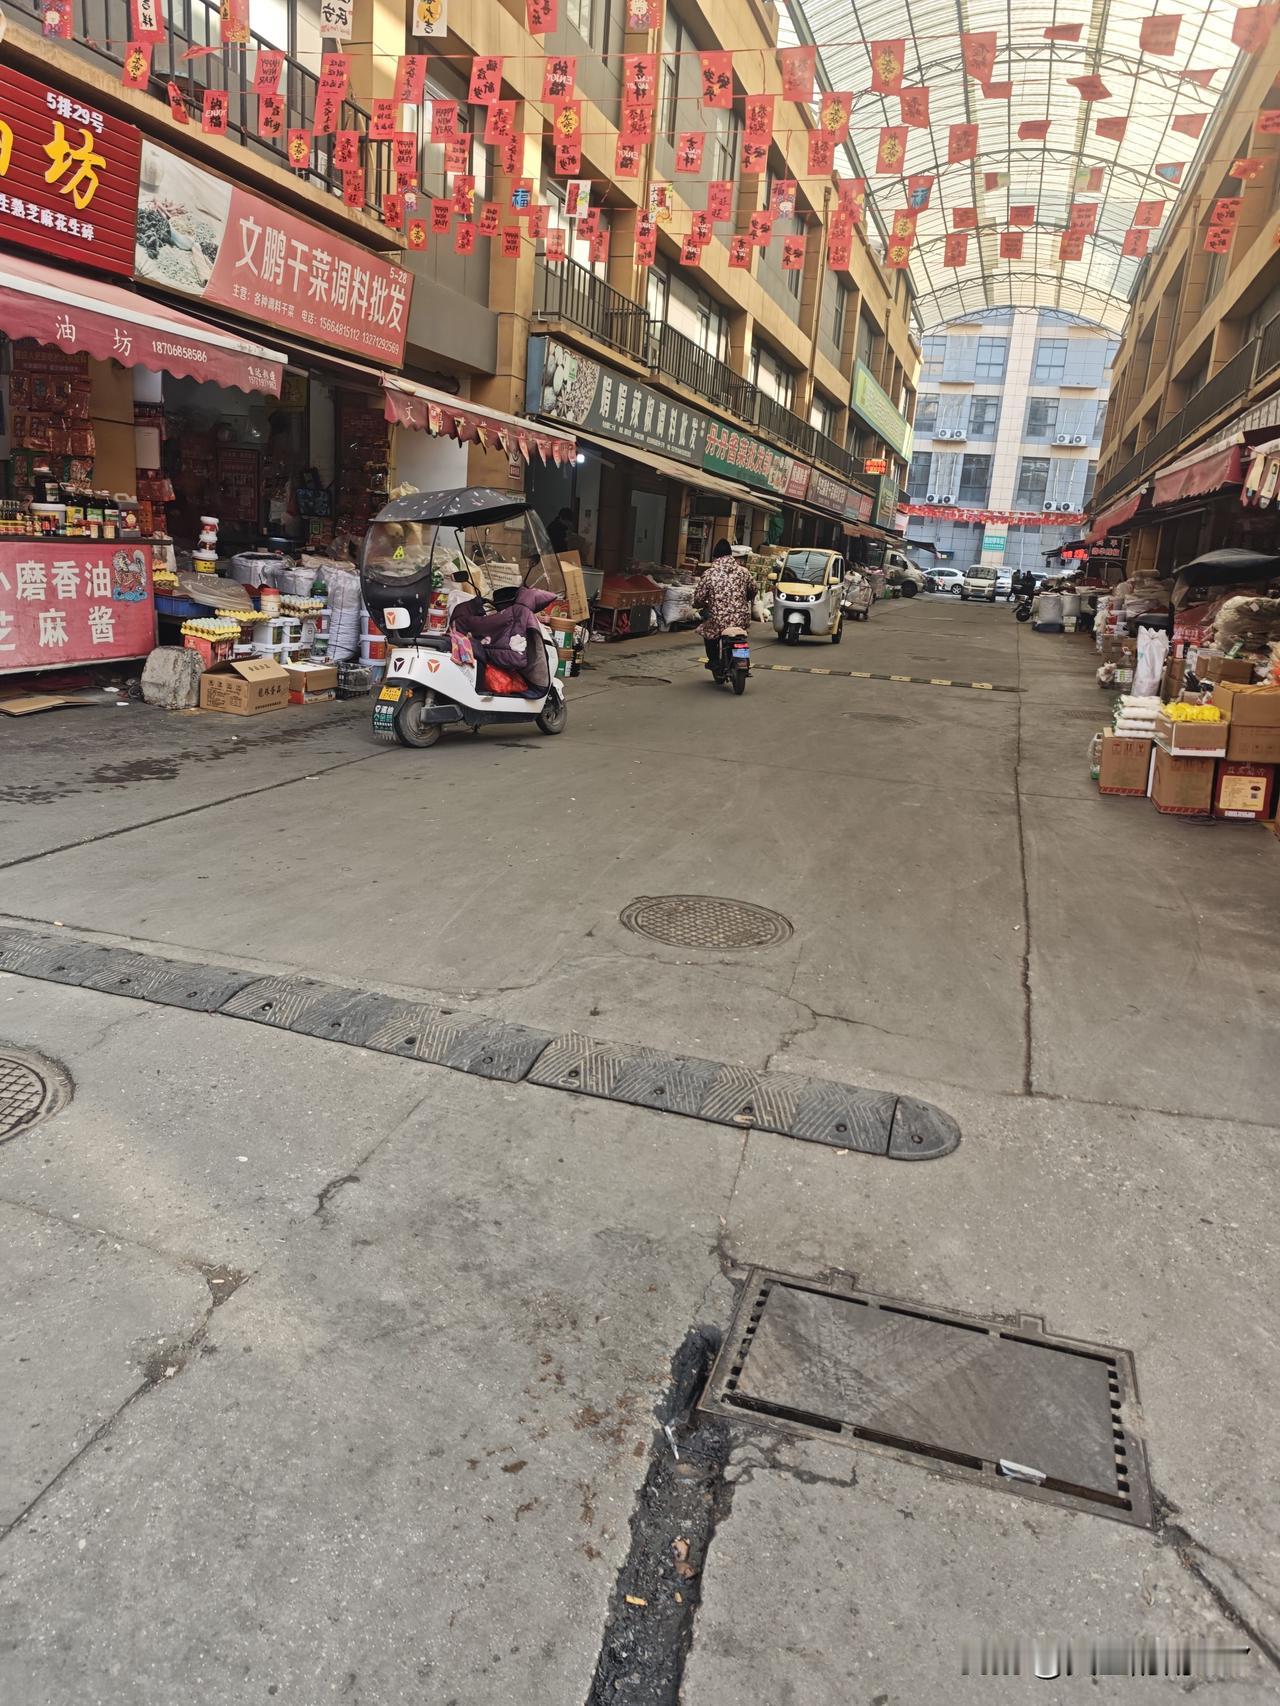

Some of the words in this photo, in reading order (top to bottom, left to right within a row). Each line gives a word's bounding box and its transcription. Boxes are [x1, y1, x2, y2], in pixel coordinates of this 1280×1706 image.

[46, 92, 104, 134] 5排29号
[512, 189, 530, 208] 福
[235, 215, 406, 333] 文鹏干菜调料批发
[389, 266, 408, 285] 5-28
